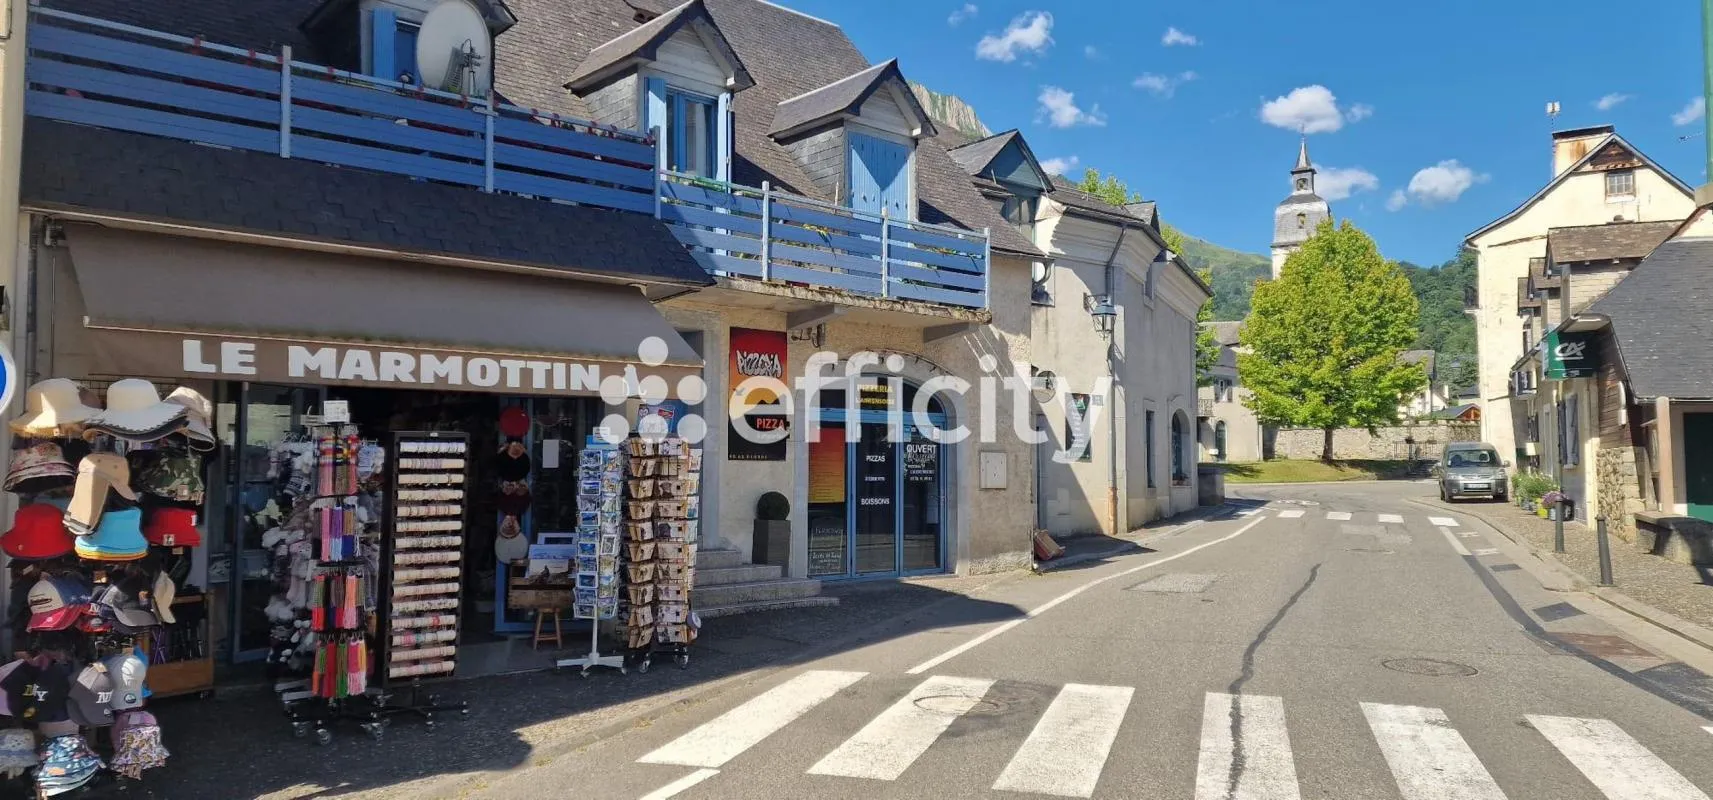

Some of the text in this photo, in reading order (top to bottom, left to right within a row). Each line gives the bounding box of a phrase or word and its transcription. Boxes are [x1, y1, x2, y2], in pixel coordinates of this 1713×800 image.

[1554, 342, 1586, 357] CA
[182, 339, 601, 392] LE MARMOTTIN
[756, 418, 785, 430] PIZZA
[906, 444, 937, 454] OUVERT
